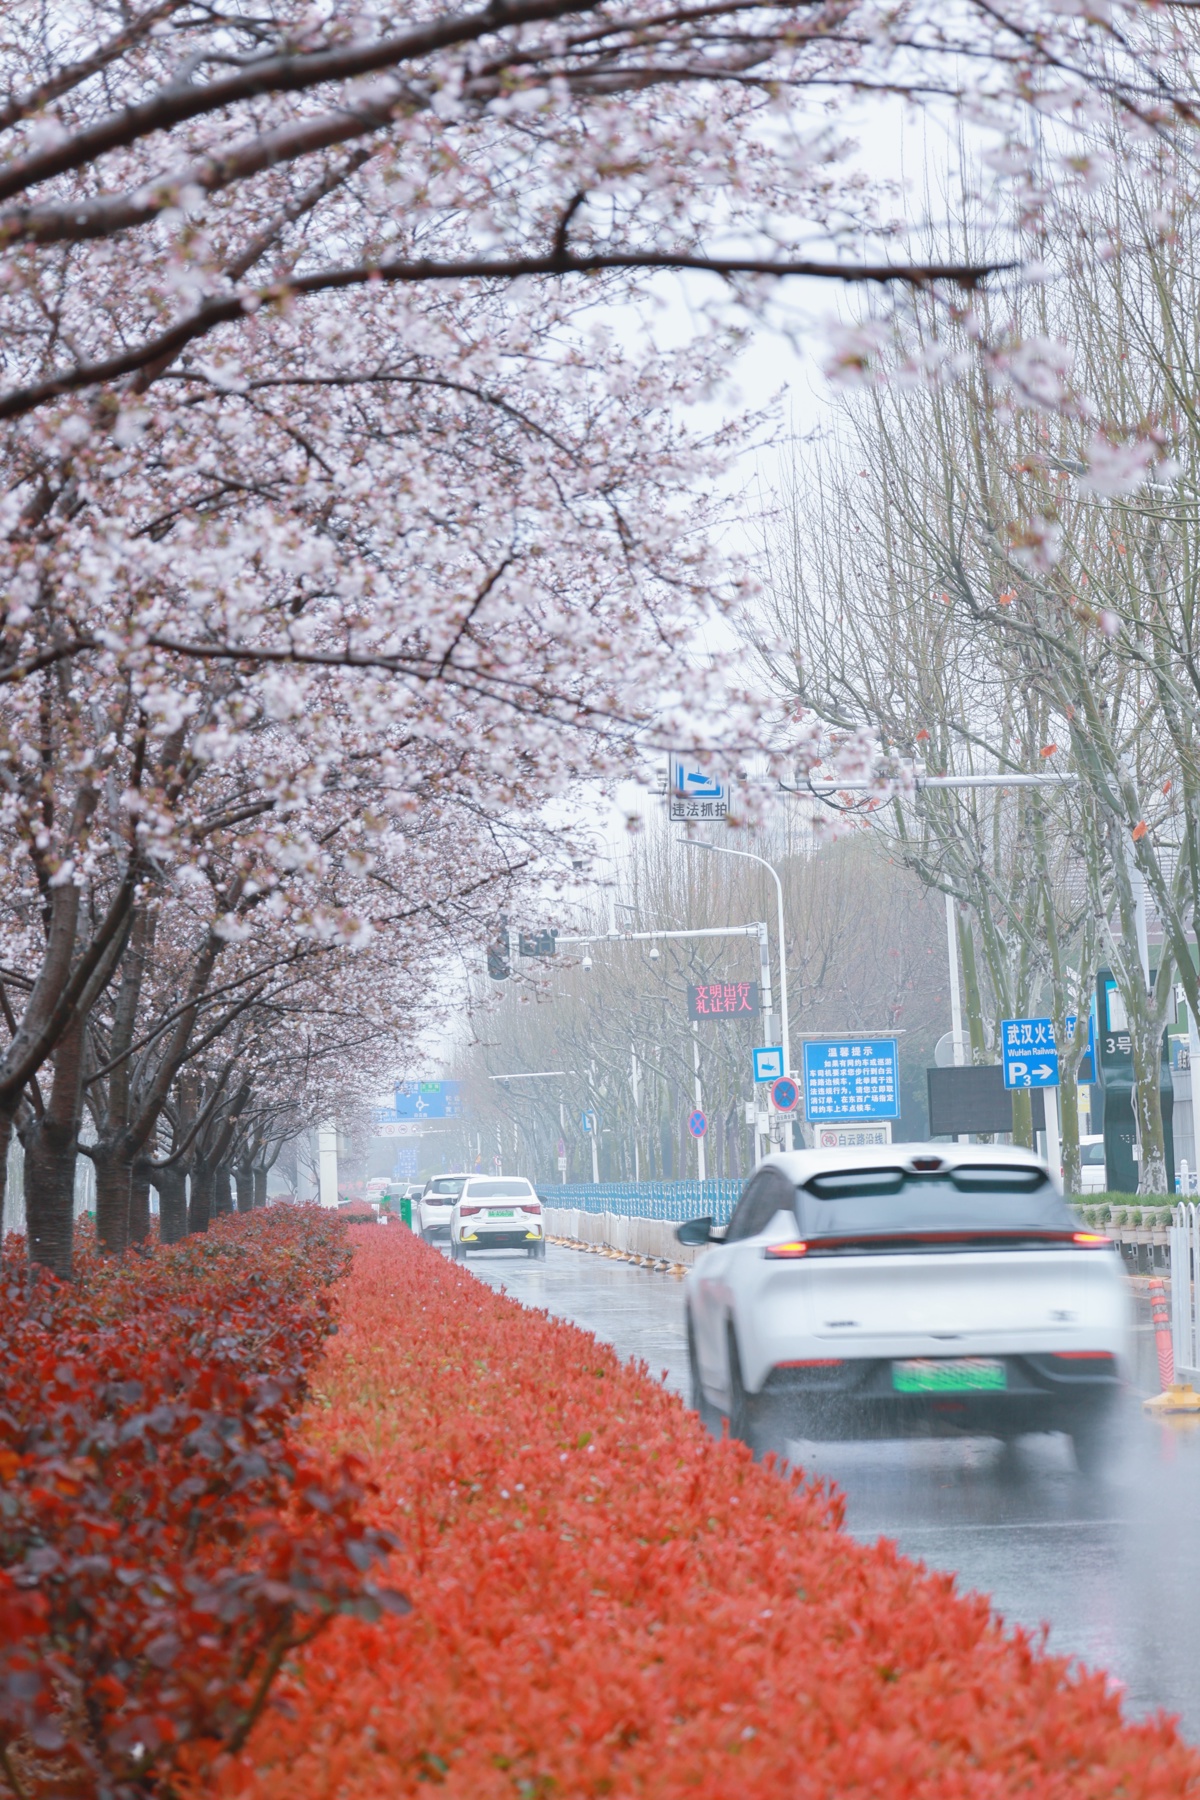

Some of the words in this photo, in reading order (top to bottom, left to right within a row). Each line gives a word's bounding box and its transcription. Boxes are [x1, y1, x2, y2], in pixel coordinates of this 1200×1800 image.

[672, 802, 727, 817] 违法抓拍
[695, 982, 751, 1000] 文明出行
[696, 996, 752, 1014] 礼让行人
[828, 1046, 873, 1057] 温馨提示
[1008, 1048, 1032, 1057] WuHan
[1032, 1047, 1058, 1057] Railway
[824, 1058, 892, 1068] 如果有网约车或巡游
[838, 1132, 884, 1146] 白云路沿线
